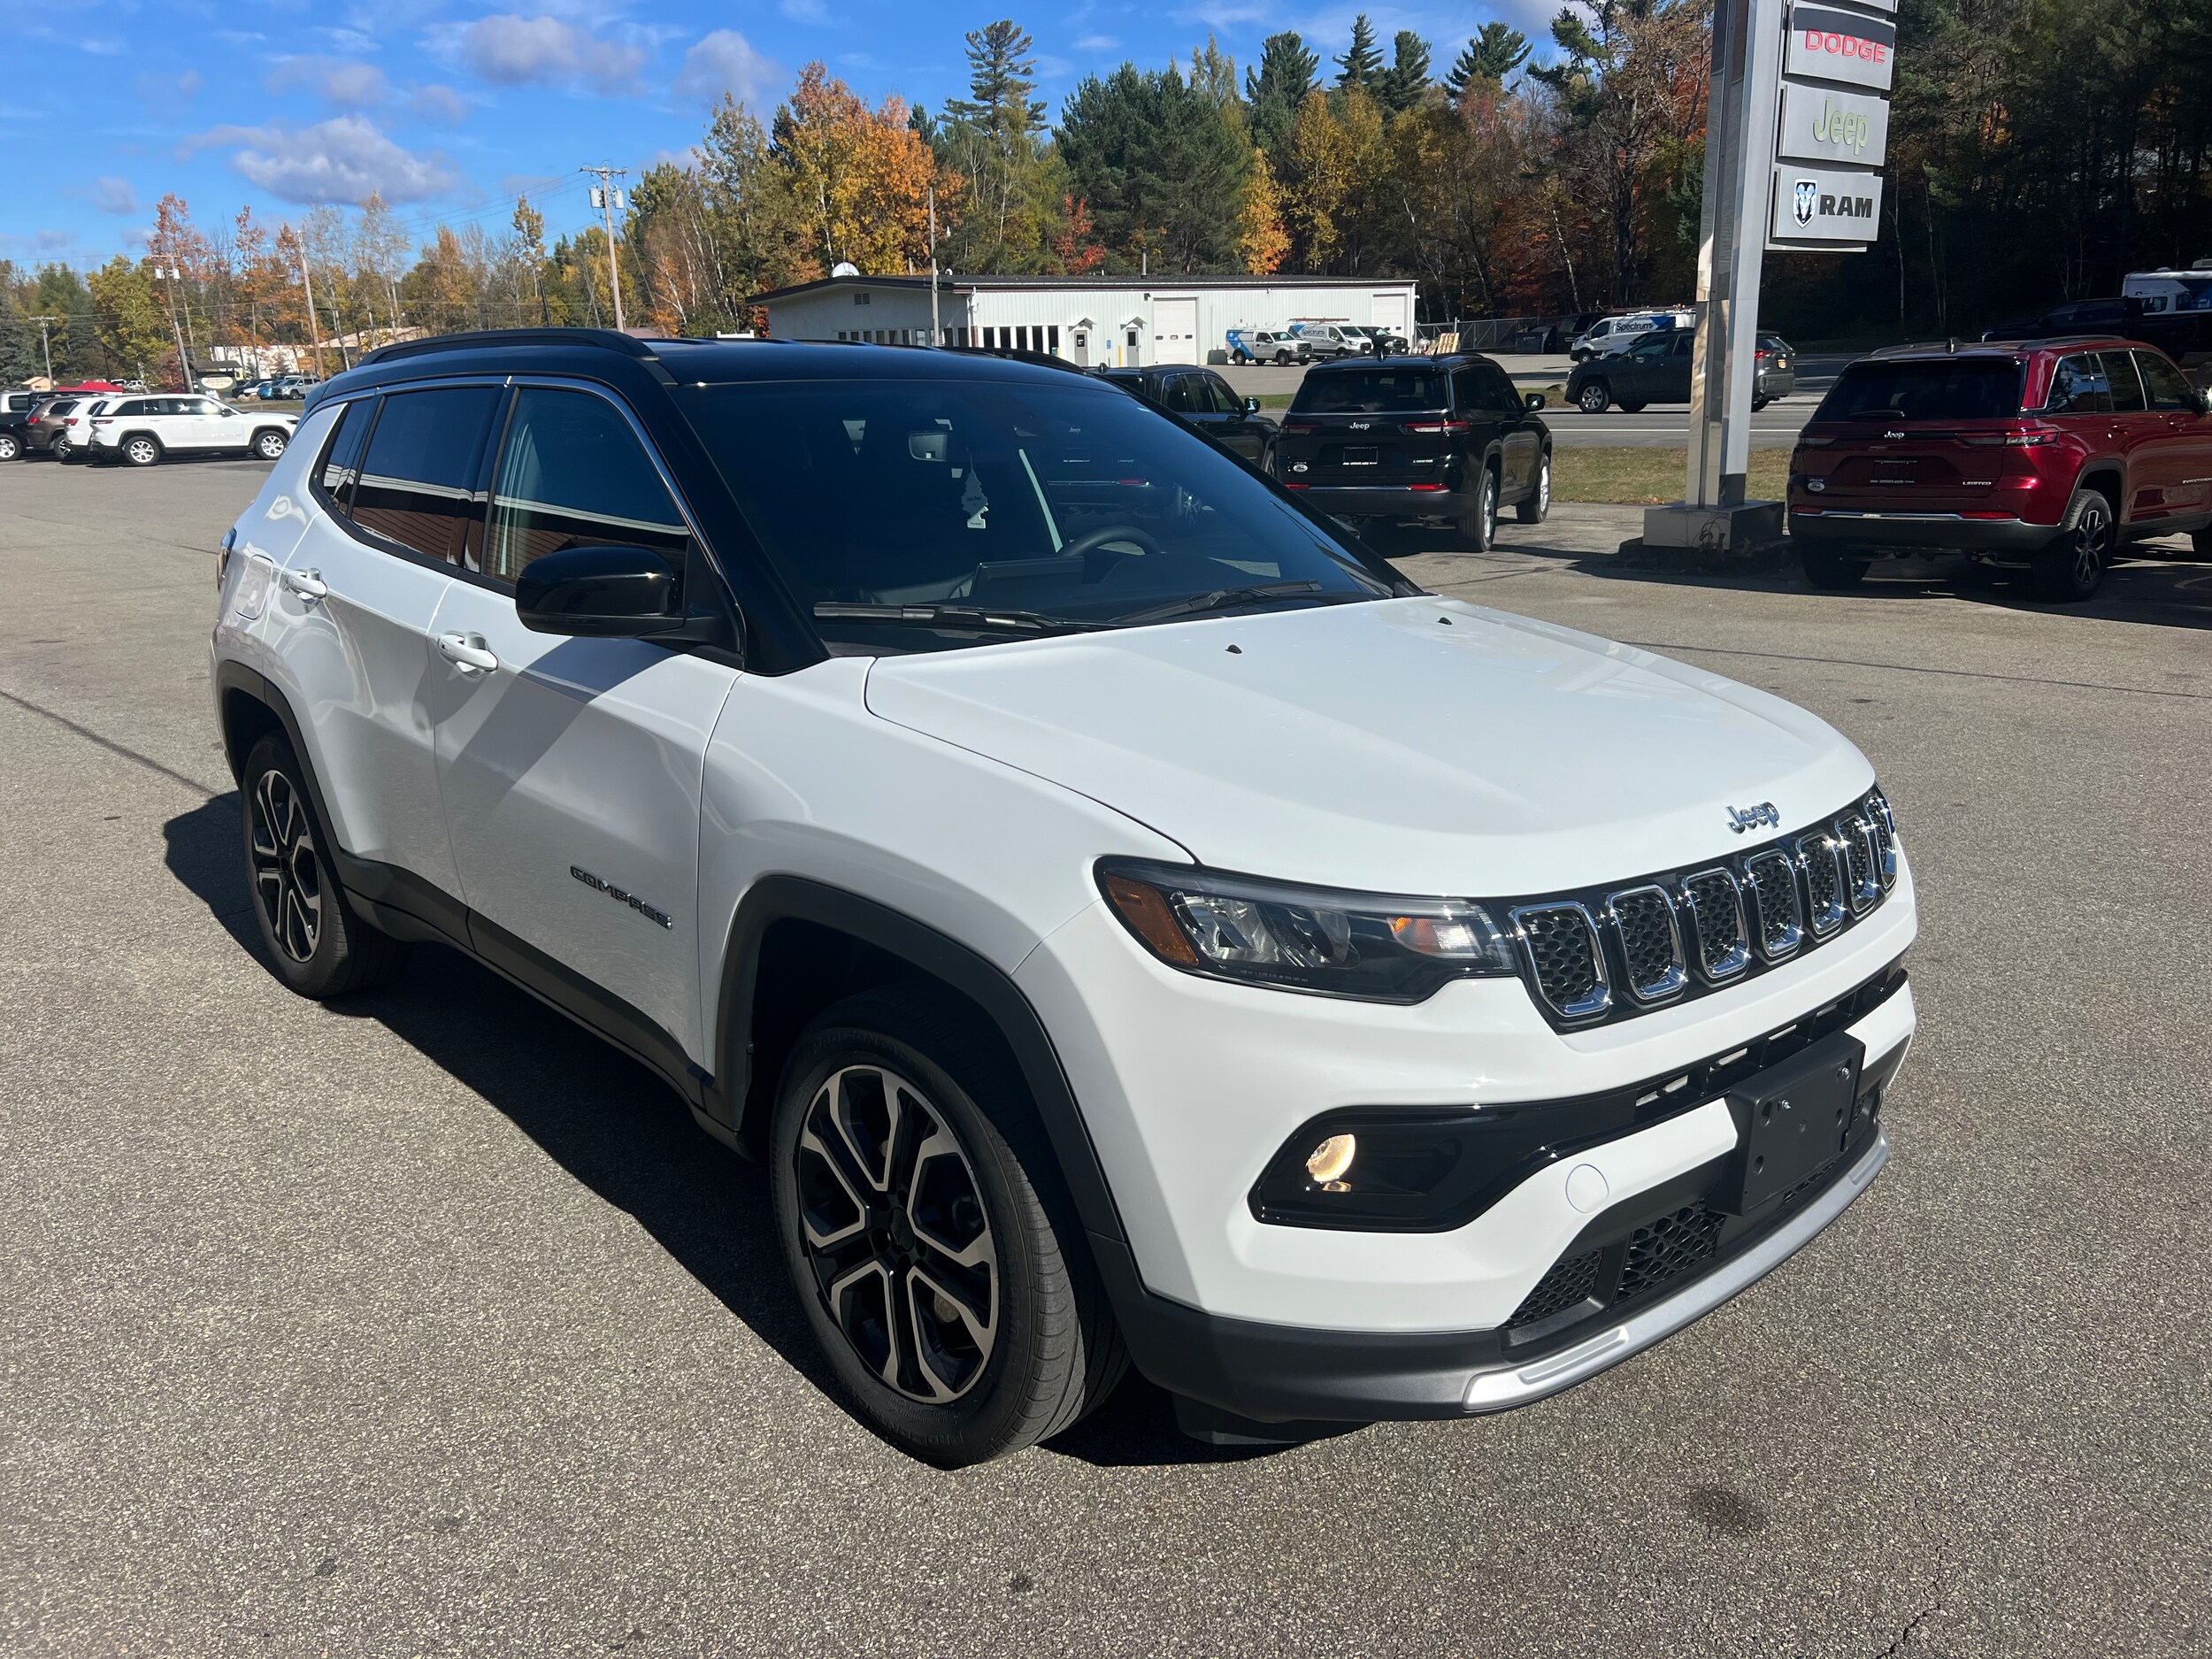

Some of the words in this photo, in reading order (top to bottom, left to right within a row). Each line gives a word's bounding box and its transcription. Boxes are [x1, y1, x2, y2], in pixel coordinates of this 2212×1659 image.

[1805, 28, 1886, 65] DODGE
[1813, 96, 1870, 156] Jeep
[1819, 194, 1873, 219] RAM
[1301, 328, 1324, 337] Spectrum
[1617, 321, 1652, 332] Spectrum
[1884, 430, 1905, 439] Jeep
[1724, 801, 1780, 834] Jeep
[570, 865, 672, 930] COMPASS
